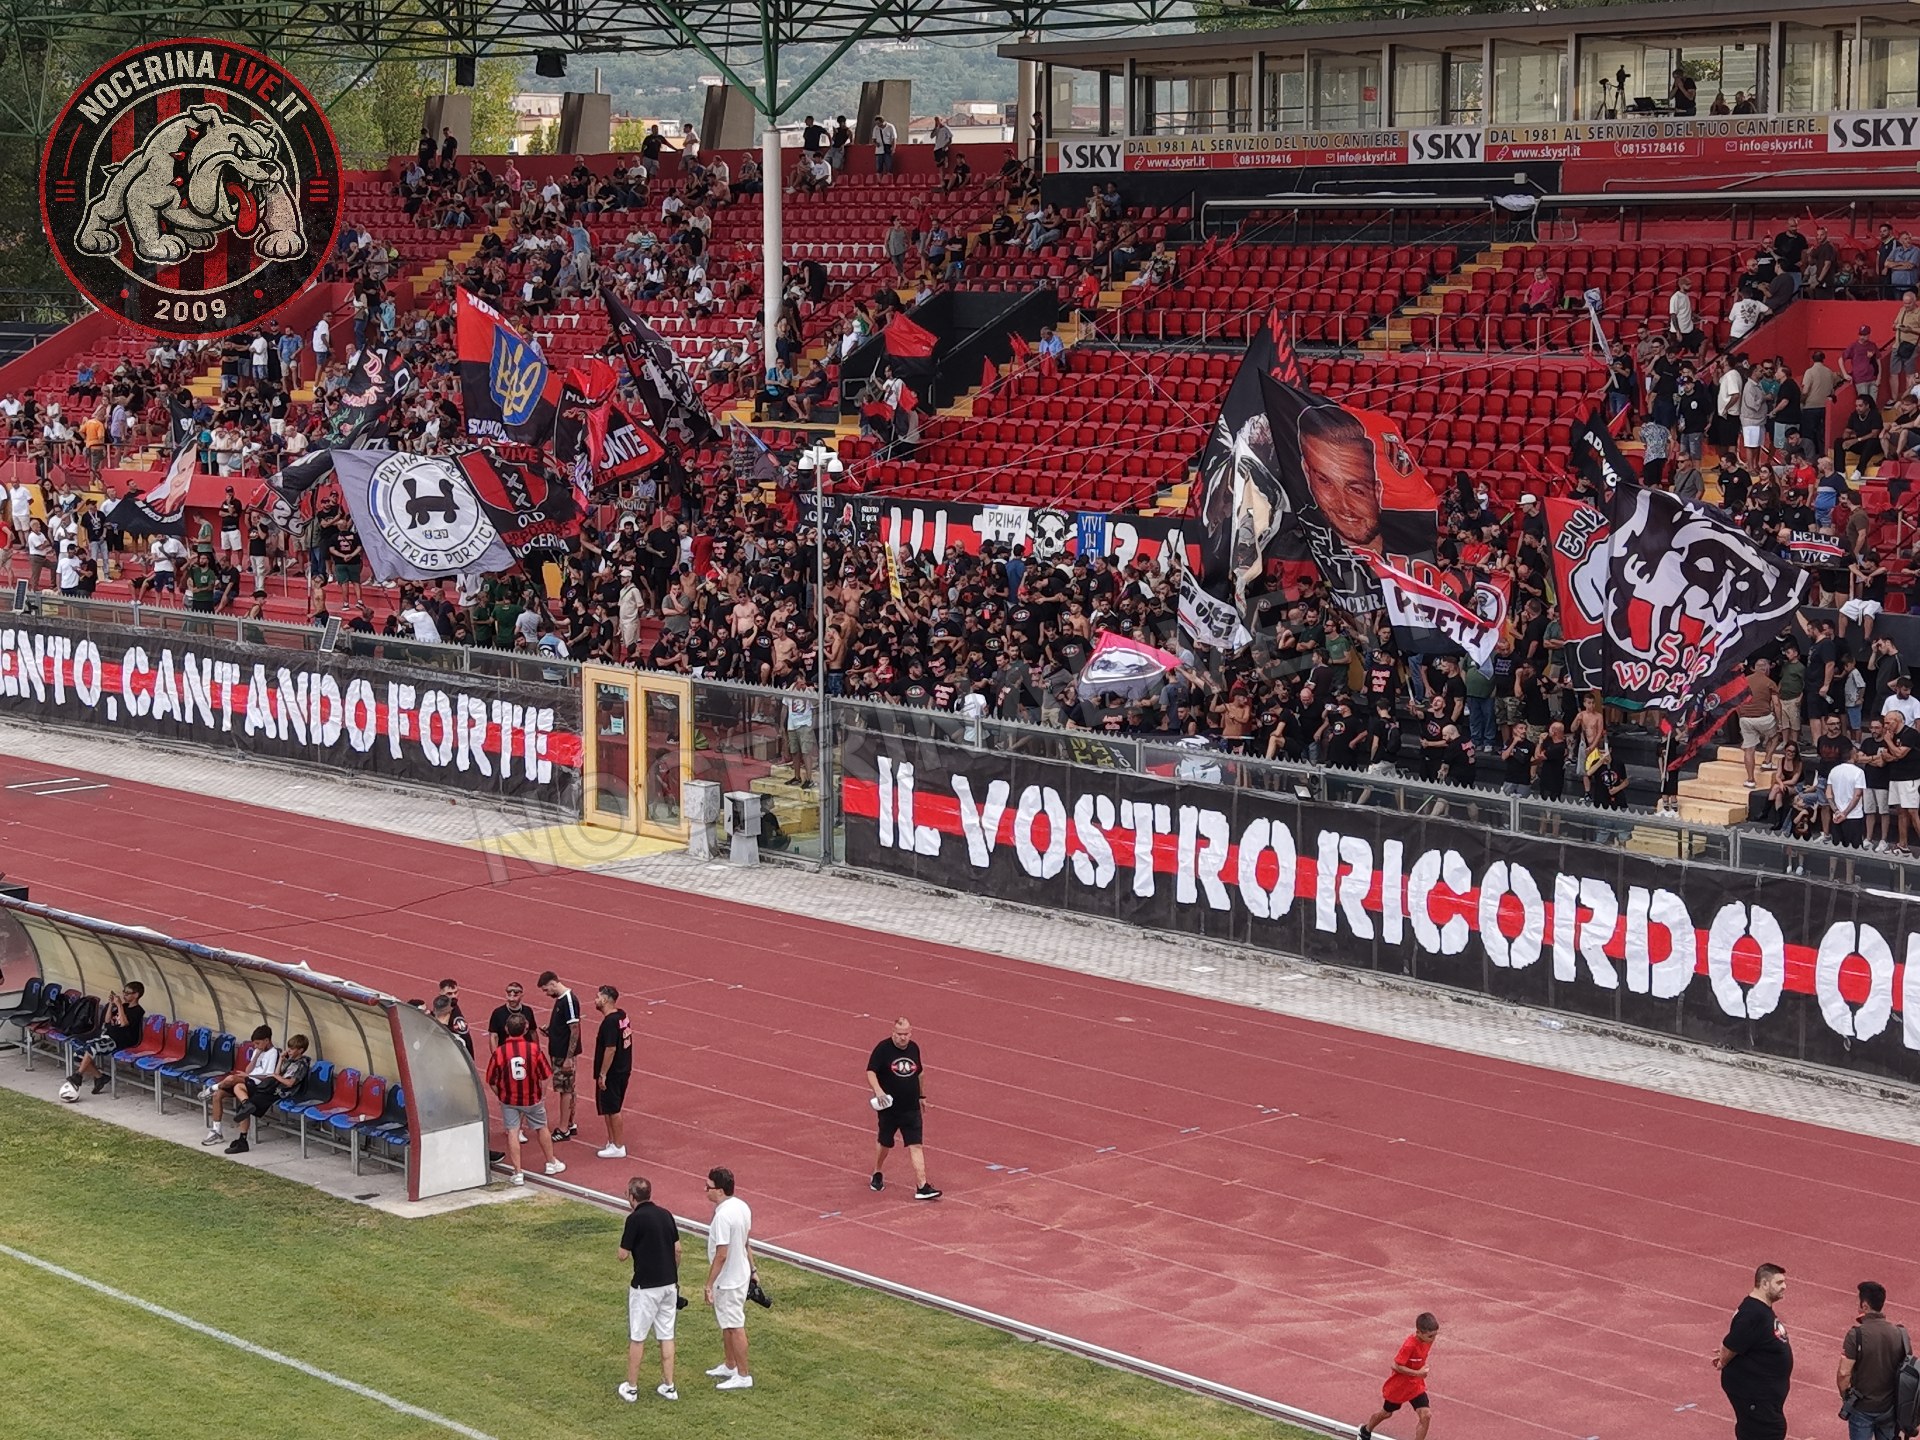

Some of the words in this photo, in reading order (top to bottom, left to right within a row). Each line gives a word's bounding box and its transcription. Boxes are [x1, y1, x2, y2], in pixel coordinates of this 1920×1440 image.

[1490, 130, 1518, 143] DAL
[1524, 128, 1557, 142] 1981
[1564, 127, 1581, 140] AL
[1588, 123, 1658, 140] SERVIZIO
[1664, 123, 1694, 137] DEL
[1697, 121, 1729, 136] TUO
[1736, 118, 1822, 135] CANTIERE.
[1852, 117, 1919, 148] SKY
[1075, 143, 1122, 169] SKY
[1128, 141, 1152, 154] DAL
[1157, 140, 1186, 152] 1981
[1190, 140, 1206, 151] AL
[1210, 136, 1269, 151] SERVIZIO
[1274, 136, 1298, 149] DEL
[1302, 135, 1329, 149] TUO
[1334, 133, 1404, 149] CANTIERE.
[1427, 133, 1482, 160] SKY
[1511, 145, 1581, 160] www.skysrl.it
[1622, 142, 1685, 154] 0815178416
[1739, 138, 1814, 153] info@skysrl.it
[1146, 156, 1206, 170] www.skysrl.it
[1239, 153, 1292, 165] 0815178416
[1336, 150, 1397, 164] info@skysrl.it
[517, 511, 547, 528] OLD
[988, 511, 1022, 529] PRIMA
[1081, 515, 1102, 531] VIVI
[122, 645, 377, 753] CANTANDO
[387, 680, 556, 785] FORTE
[876, 755, 941, 859] IL
[949, 773, 1298, 920] VOSTRO
[1314, 827, 1785, 1021] RICORDO
[510, 1056, 526, 1081] 6
